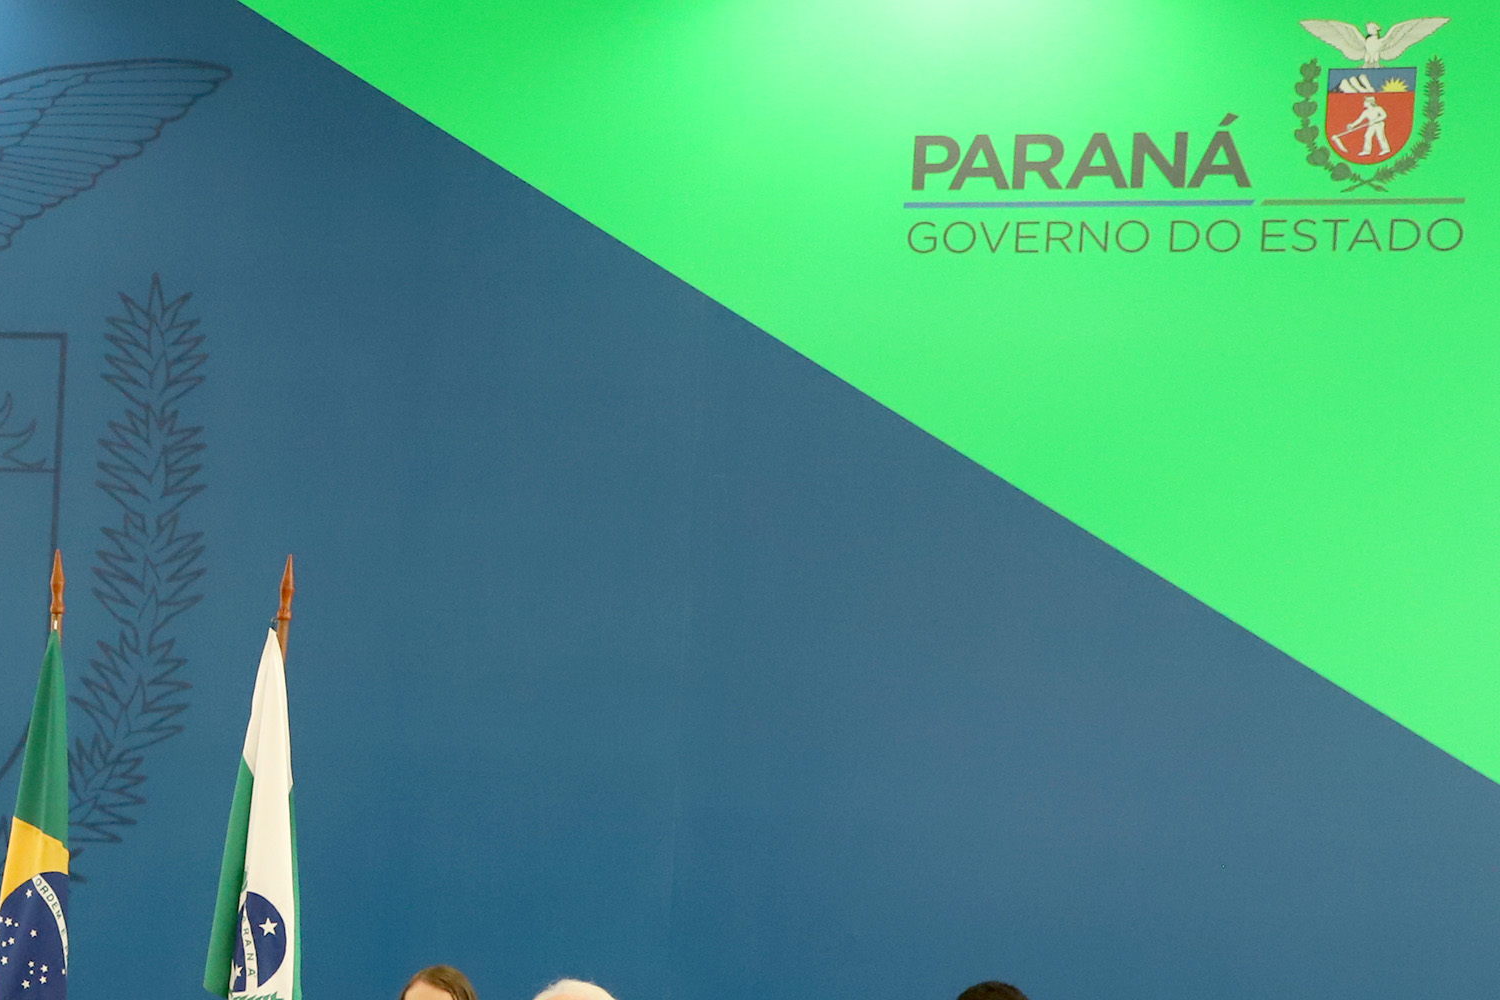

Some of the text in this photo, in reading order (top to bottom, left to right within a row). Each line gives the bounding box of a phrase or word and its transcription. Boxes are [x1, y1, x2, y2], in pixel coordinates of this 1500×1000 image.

[911, 113, 1252, 190] PARANÁ
[907, 217, 1465, 254] GOVERNO DO ESTADO
[35, 877, 61, 919] ORDEM
